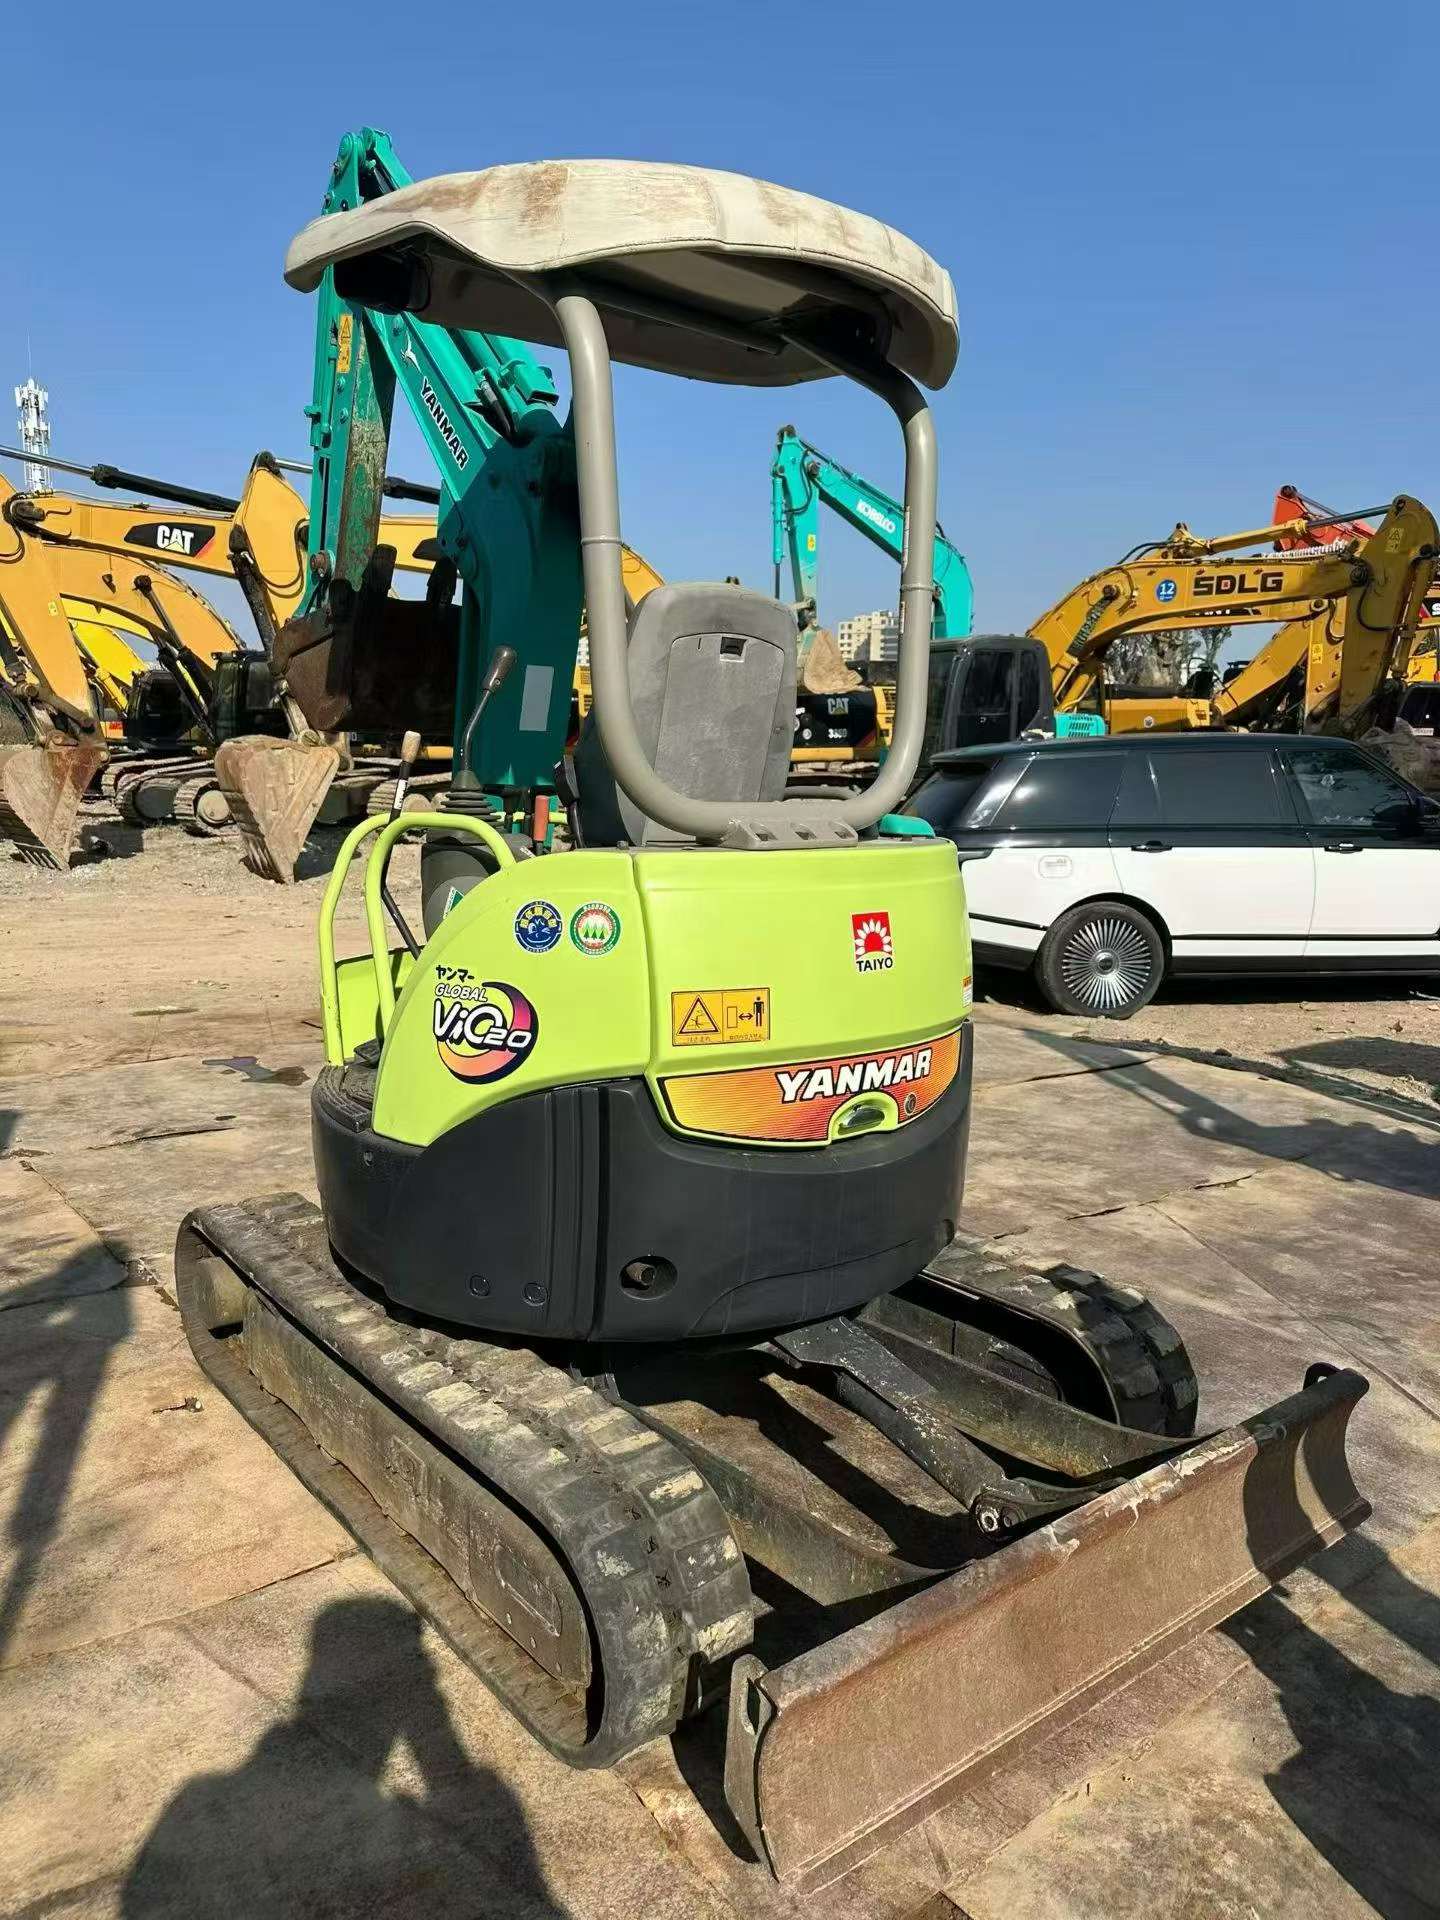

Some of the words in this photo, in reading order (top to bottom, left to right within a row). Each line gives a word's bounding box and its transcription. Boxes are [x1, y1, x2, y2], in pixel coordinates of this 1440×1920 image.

[421, 376, 469, 470] YANMAR
[156, 525, 195, 555] CAT
[1159, 582, 1175, 595] 12
[1193, 572, 1283, 596] SDLG
[827, 697, 849, 715] CAT
[435, 964, 475, 982] ヤンマー
[856, 956, 893, 972] TAIYO
[435, 983, 488, 1002] GLOBAL
[776, 1048, 932, 1103] YANMAR
